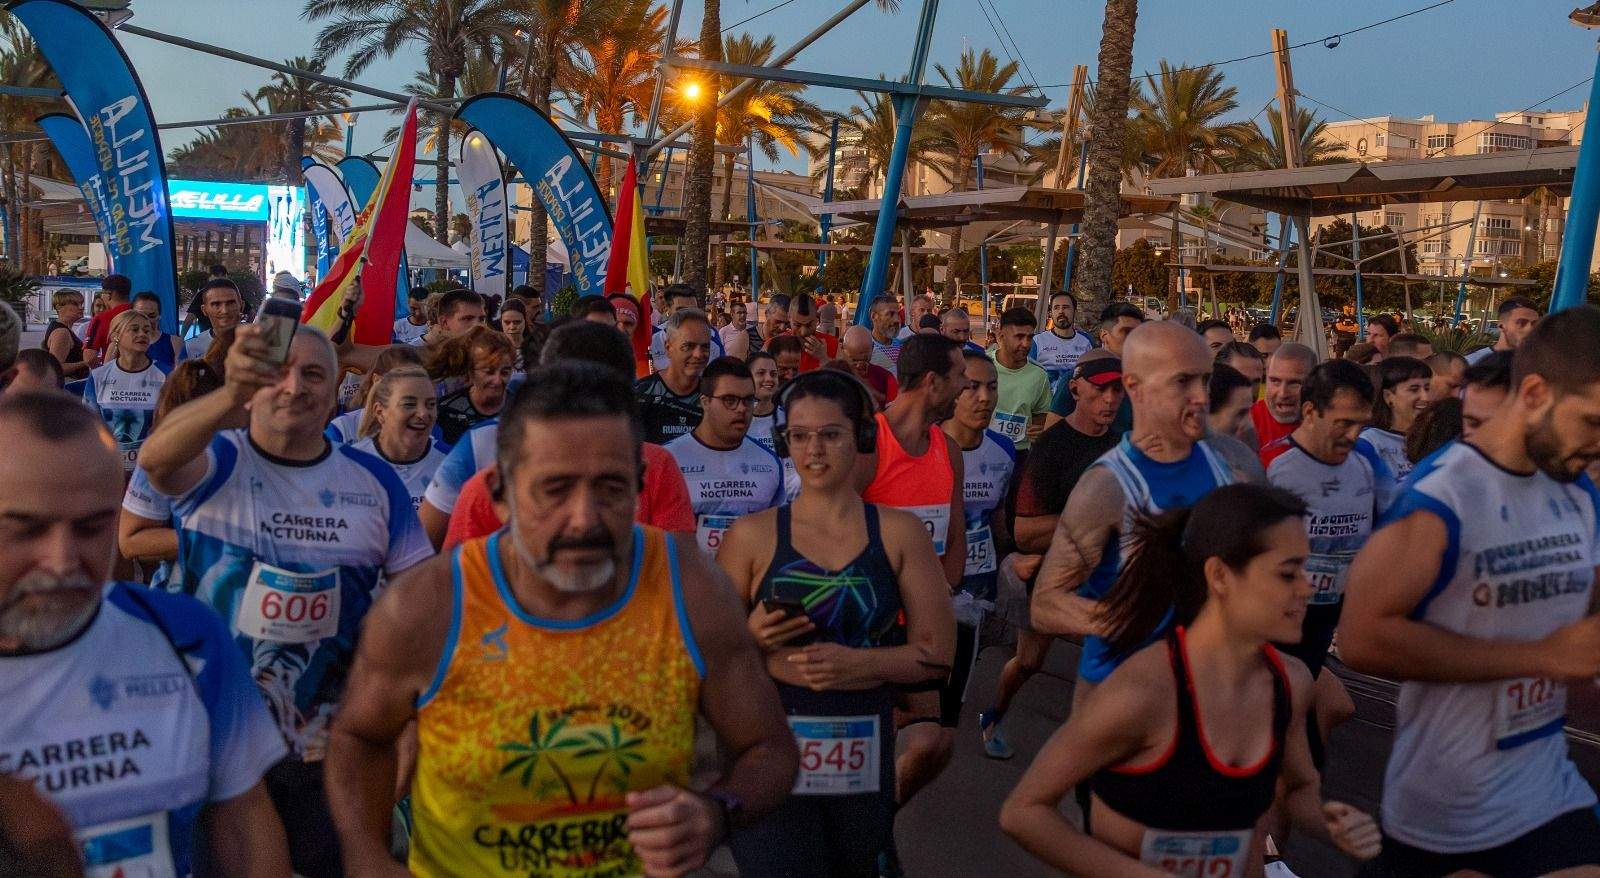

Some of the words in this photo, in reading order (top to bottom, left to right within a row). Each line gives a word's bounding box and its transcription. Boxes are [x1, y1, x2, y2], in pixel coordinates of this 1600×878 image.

[998, 421, 1020, 435] 196
[714, 480, 757, 489] CARRERA
[963, 482, 993, 490] RRERA
[700, 490, 753, 498] NOCTURNA
[272, 512, 348, 529] CARRERA
[261, 521, 340, 543] NCTURNA
[260, 591, 328, 622] 606
[800, 740, 865, 772] 545
[38, 757, 141, 792] URNA
